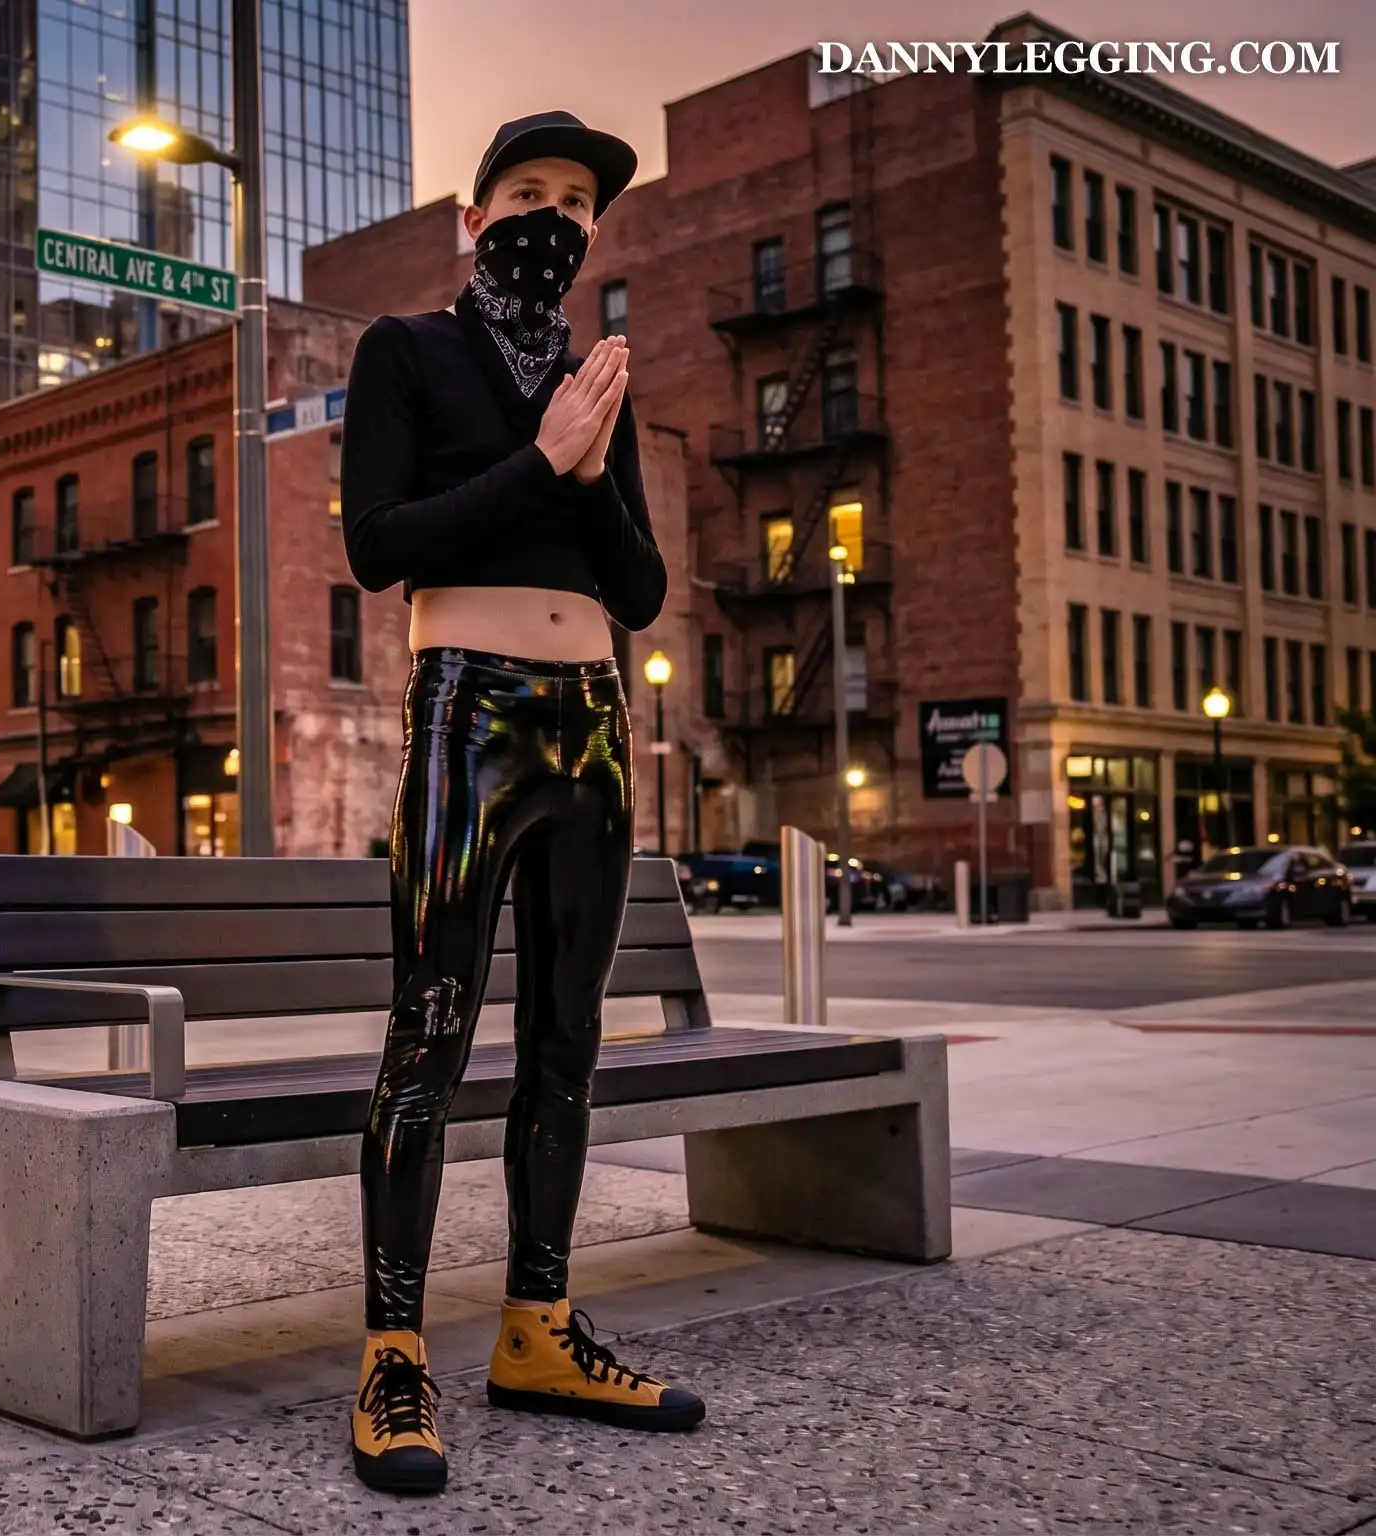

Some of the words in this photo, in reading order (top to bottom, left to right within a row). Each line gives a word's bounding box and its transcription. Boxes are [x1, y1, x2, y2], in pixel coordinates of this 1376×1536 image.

[43, 238, 119, 280] CENTRAL
[126, 257, 157, 288] AVE
[162, 265, 174, 292] &
[180, 270, 205, 295] 4TH
[211, 276, 230, 304] ST
